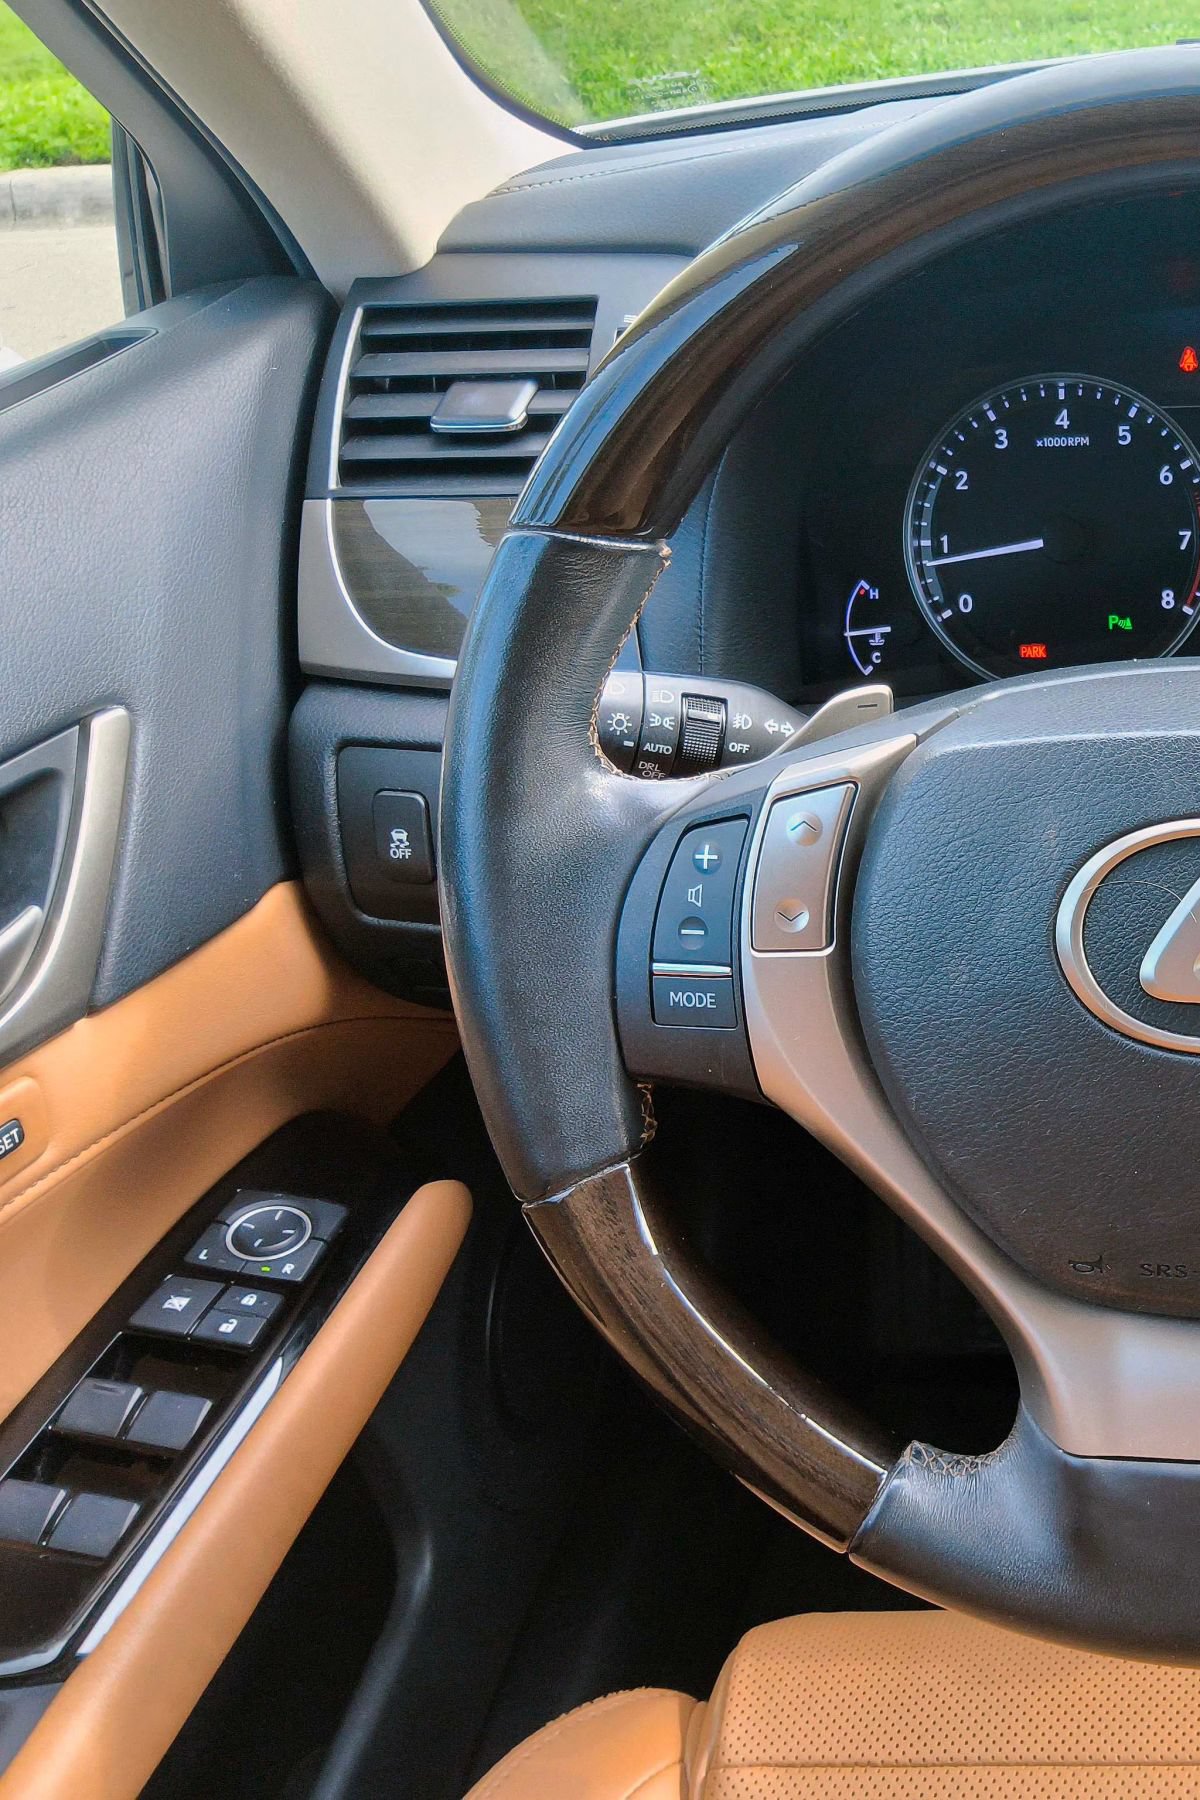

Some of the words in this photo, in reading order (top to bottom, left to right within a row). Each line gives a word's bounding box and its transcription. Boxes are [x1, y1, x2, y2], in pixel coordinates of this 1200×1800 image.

[1055, 408, 1070, 429] 4
[995, 428, 1008, 449] 3
[1118, 425, 1131, 445] 5
[955, 470, 969, 490] 2
[1159, 465, 1173, 485] 6
[940, 534, 949, 554] 1
[1178, 530, 1192, 550] 7
[869, 588, 879, 599] H
[1161, 589, 1175, 609] 8
[959, 594, 973, 613] 0
[872, 652, 881, 663] C
[1020, 643, 1047, 659] PARK
[643, 742, 673, 756] AUTO
[728, 742, 750, 755] OFF
[638, 761, 660, 772] DRL
[641, 770, 666, 780] OFF
[389, 848, 412, 859] OFF
[669, 991, 717, 1009] MODE
[198, 1248, 209, 1262] L
[280, 1262, 296, 1275] R
[1139, 1262, 1189, 1279] SRS
